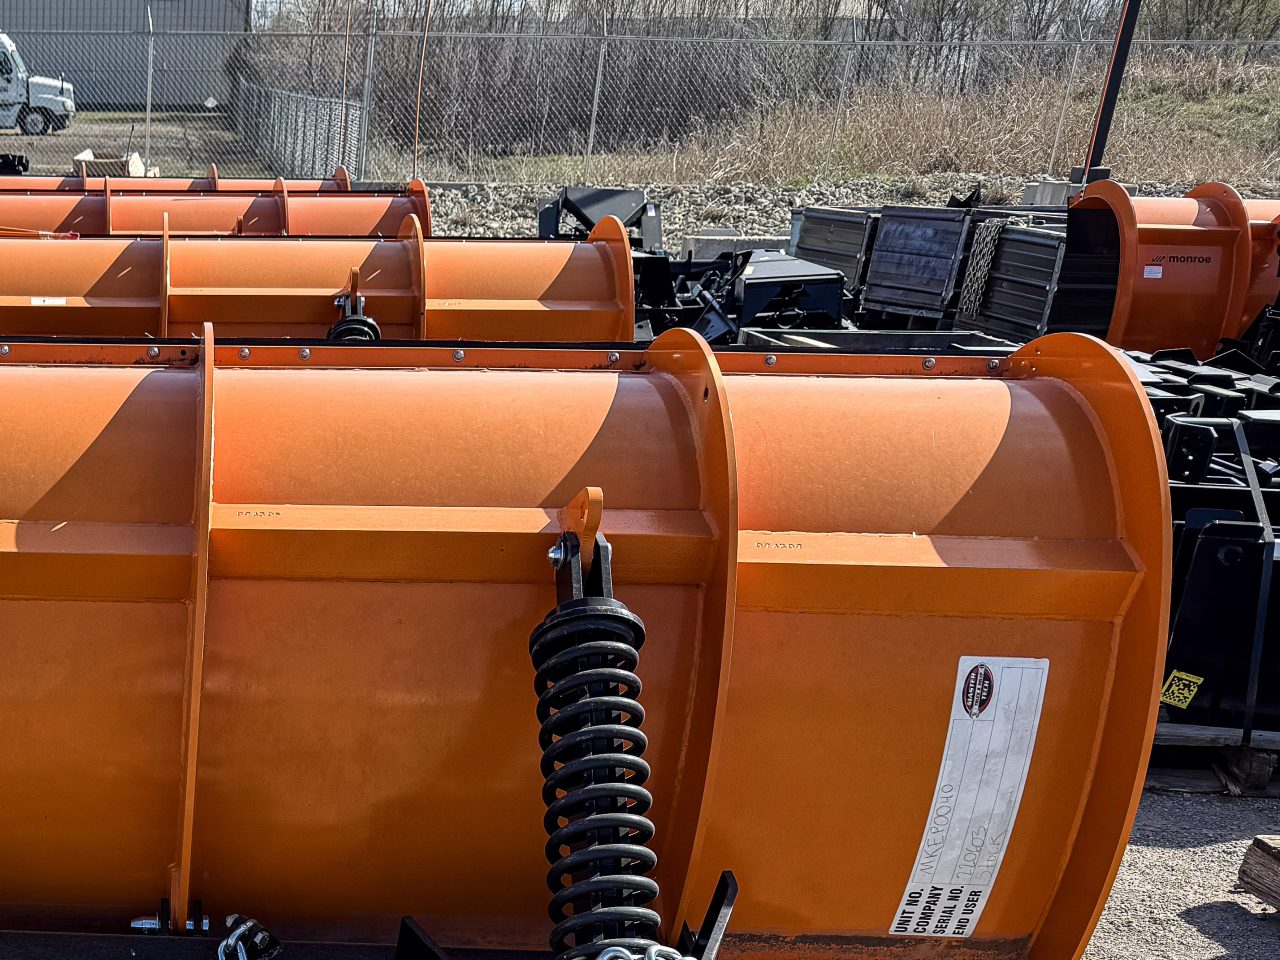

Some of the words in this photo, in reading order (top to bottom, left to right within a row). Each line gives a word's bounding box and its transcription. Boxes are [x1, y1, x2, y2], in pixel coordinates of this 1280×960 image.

[1169, 256, 1211, 264] monroe
[967, 672, 977, 707] MASTER
[981, 680, 990, 700] TECH
[920, 784, 953, 875] MKEP0040
[894, 909, 915, 932] UNIT
[905, 888, 924, 906] NO.
[913, 886, 944, 933] COMPANY
[932, 904, 957, 934] SERIAL
[947, 886, 964, 901] NO.
[952, 918, 969, 935] END
[961, 890, 982, 915] USER
